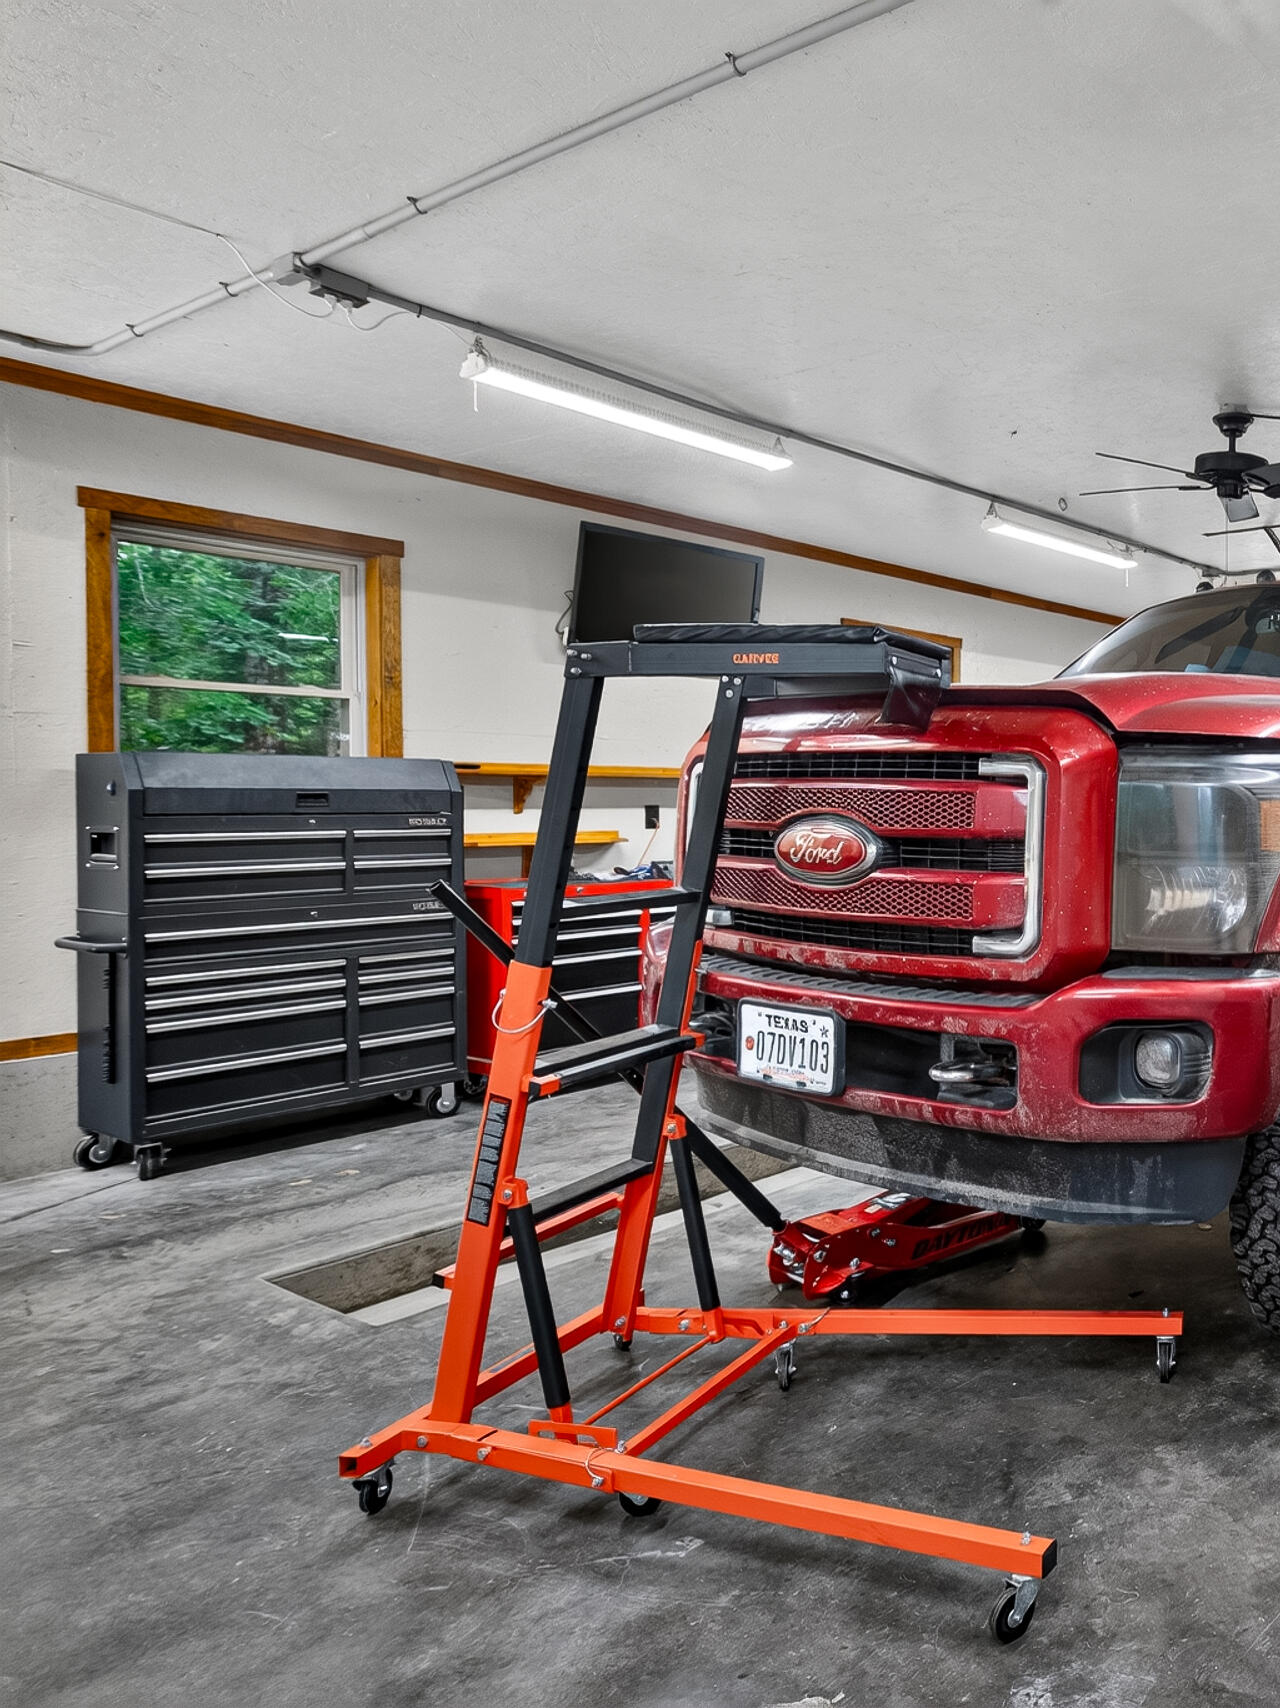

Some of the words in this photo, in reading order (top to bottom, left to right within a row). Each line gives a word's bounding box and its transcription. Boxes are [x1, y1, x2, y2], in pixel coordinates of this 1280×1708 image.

[789, 831, 845, 863] Ford
[765, 1014, 809, 1033] TEXAS
[756, 1030, 829, 1074] 07DV103
